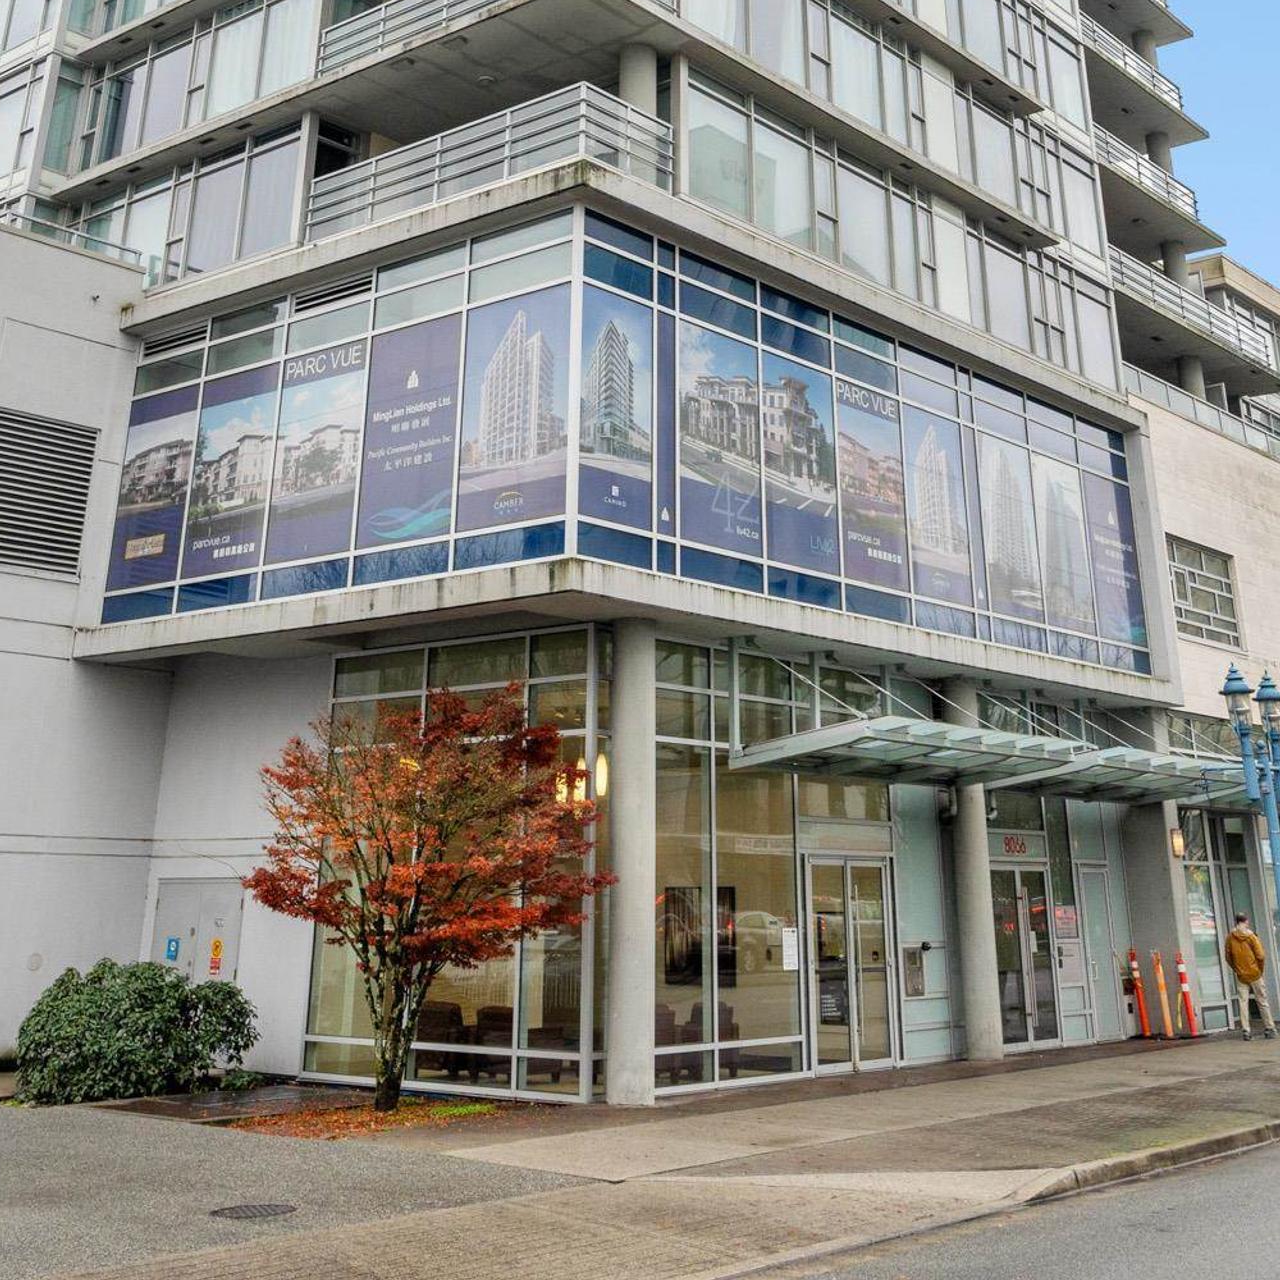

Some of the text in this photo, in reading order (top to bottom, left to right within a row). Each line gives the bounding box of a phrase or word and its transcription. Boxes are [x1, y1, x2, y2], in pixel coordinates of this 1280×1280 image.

[286, 345, 362, 381] PARC VUE
[836, 381, 897, 418] PARC VUE
[1004, 836, 1027, 854] 8066
